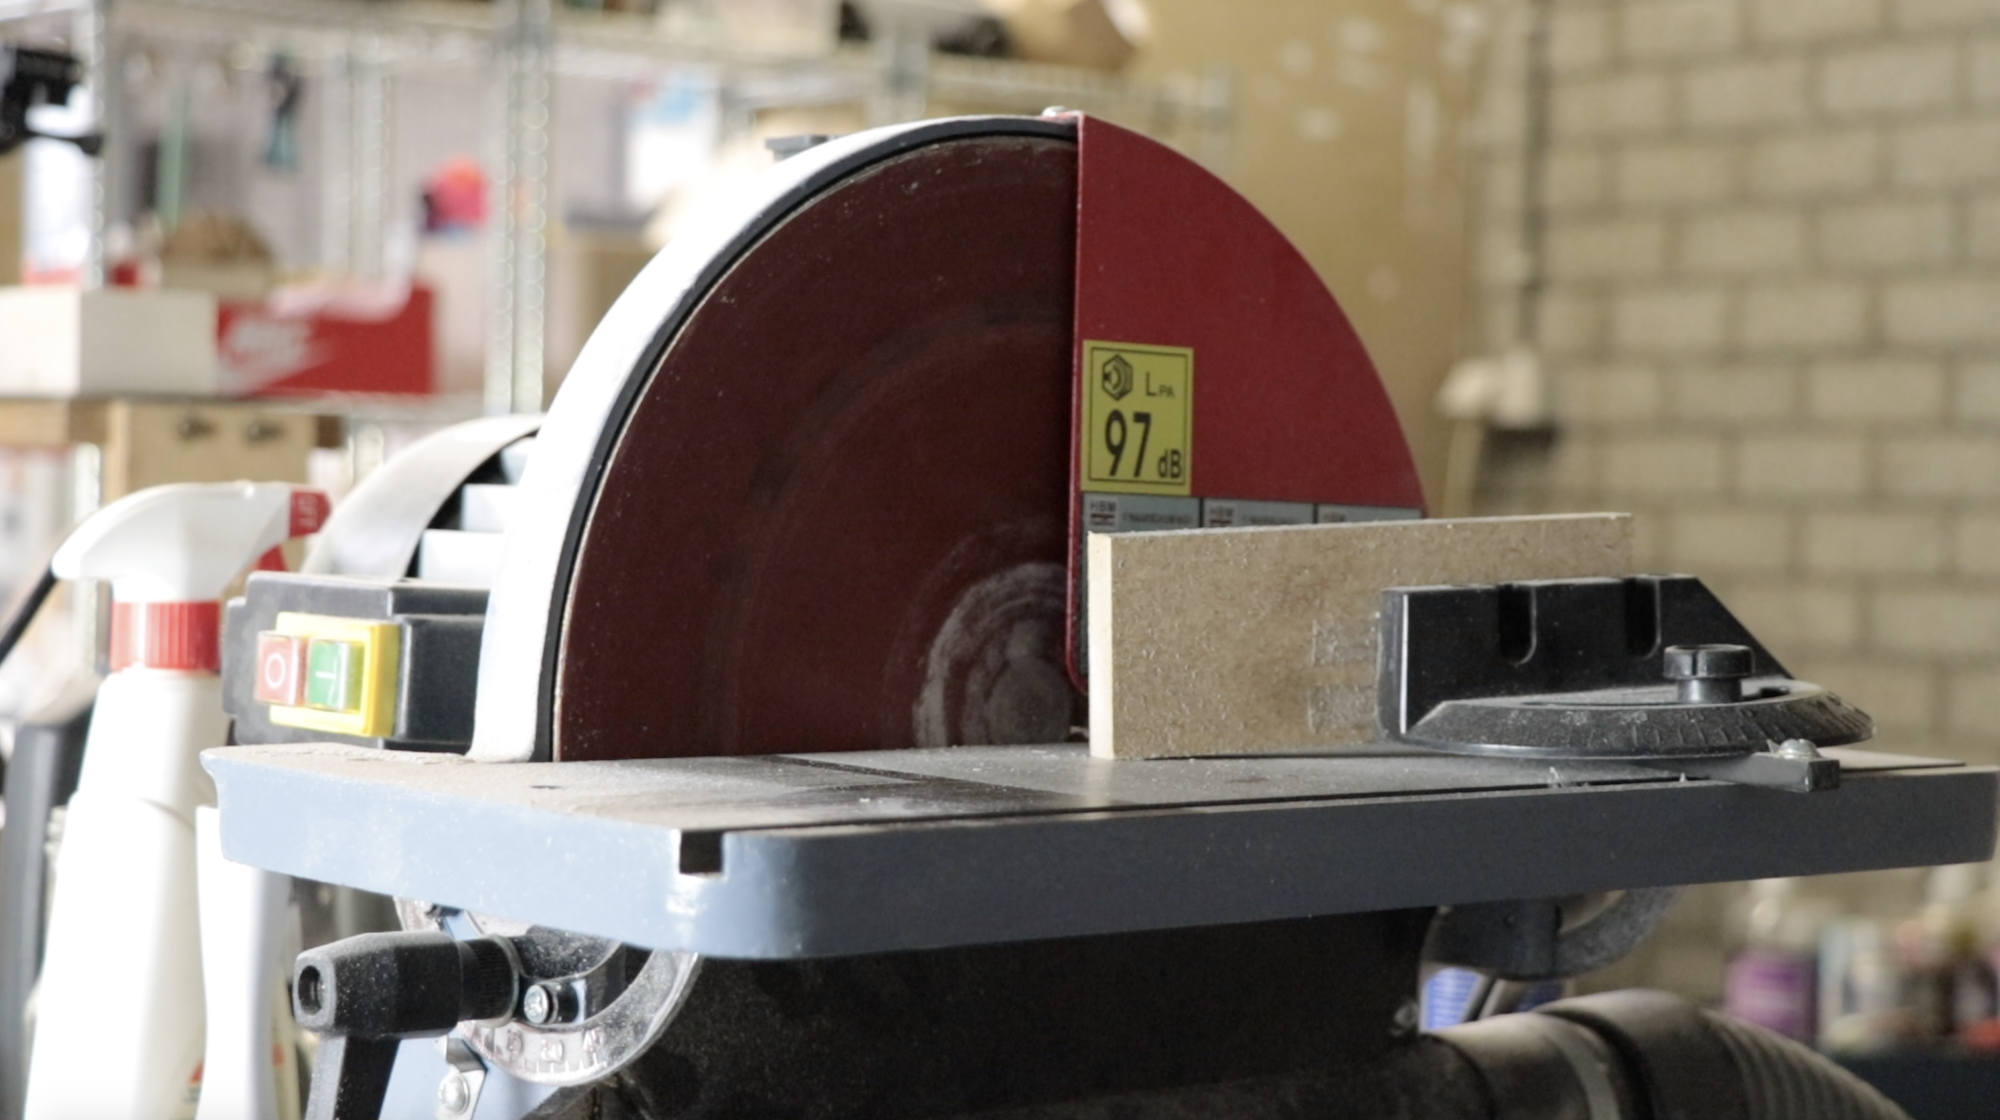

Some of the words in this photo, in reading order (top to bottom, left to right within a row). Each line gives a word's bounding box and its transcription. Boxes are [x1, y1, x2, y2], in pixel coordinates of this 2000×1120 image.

[1105, 409, 1152, 478] 97
[1158, 449, 1182, 478] dB
[1090, 500, 1117, 512] HBM
